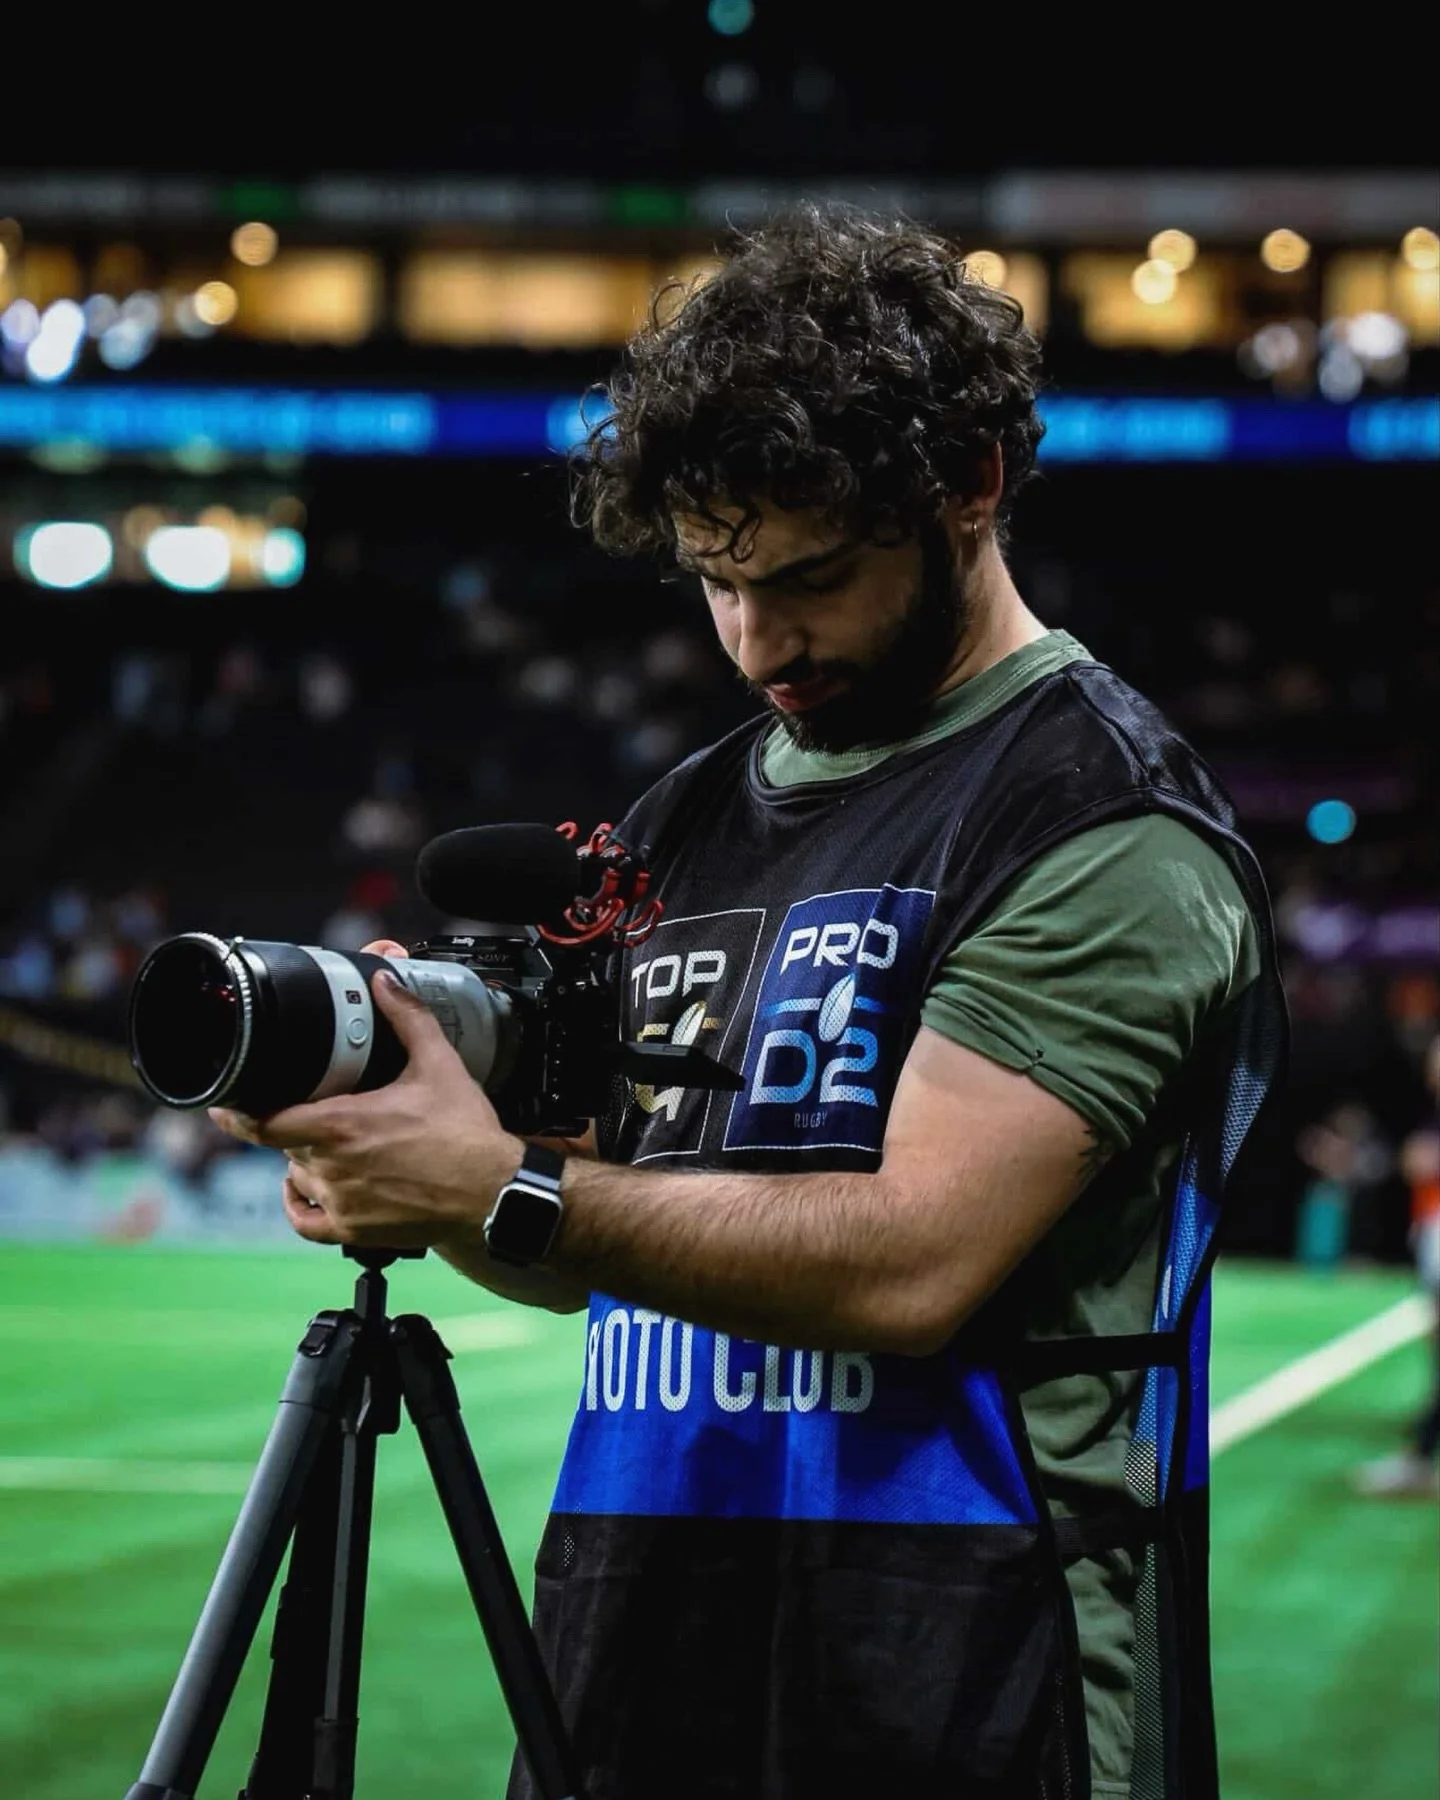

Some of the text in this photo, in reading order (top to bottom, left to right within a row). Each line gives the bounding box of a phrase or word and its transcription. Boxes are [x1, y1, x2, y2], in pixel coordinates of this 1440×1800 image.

[477, 953, 510, 963] SONY
[780, 918, 899, 974] PRO
[631, 950, 727, 1008] TOP
[750, 1027, 878, 1107] D2
[794, 1111, 828, 1128] RUGBY
[713, 1333, 875, 1413] CLUB
